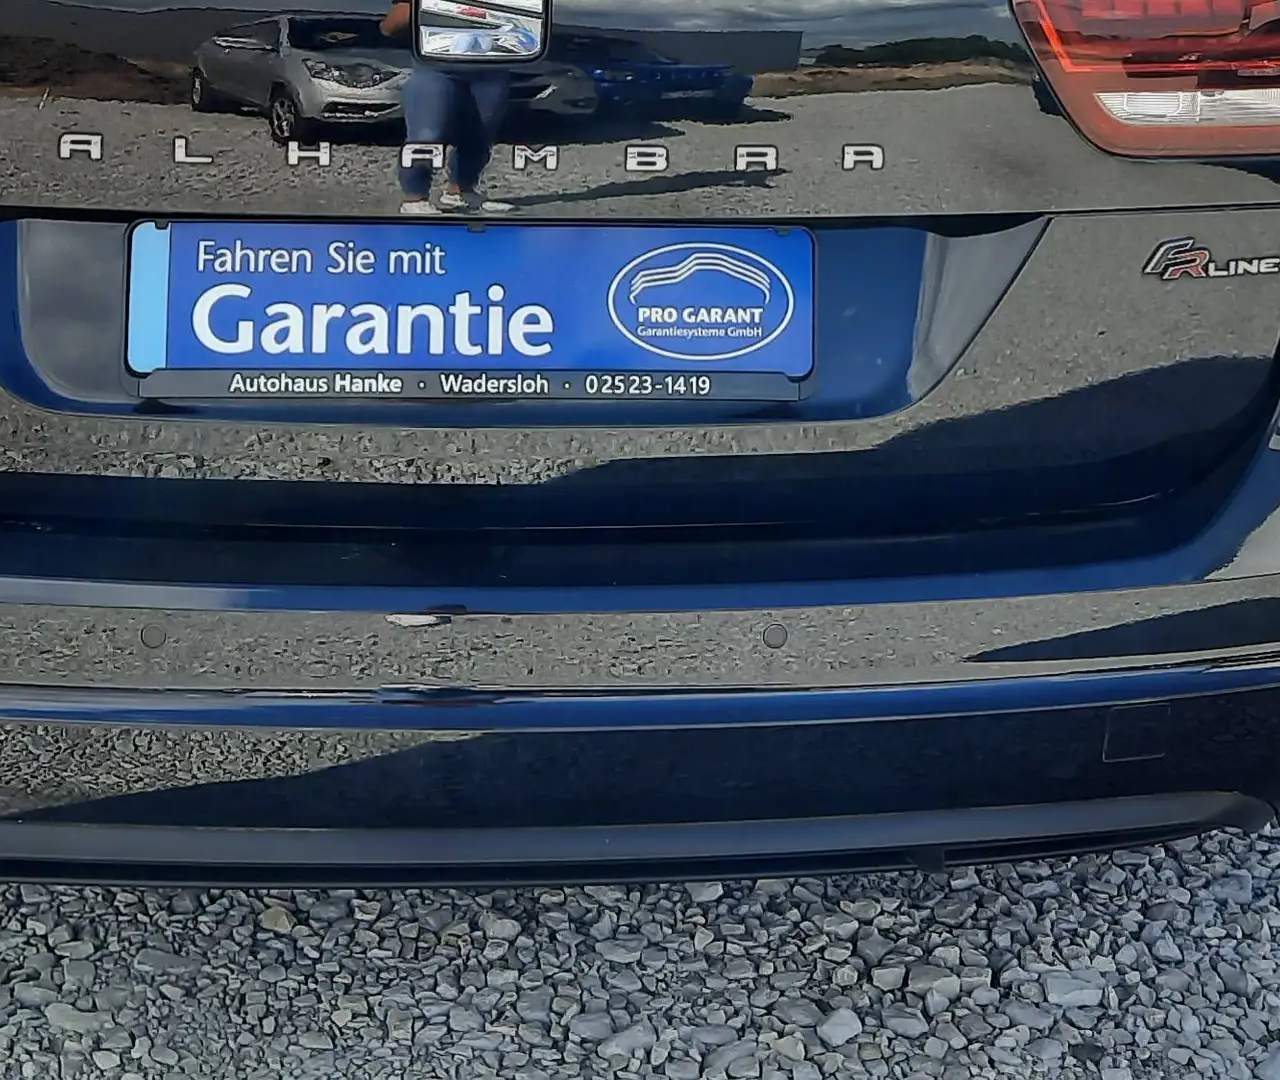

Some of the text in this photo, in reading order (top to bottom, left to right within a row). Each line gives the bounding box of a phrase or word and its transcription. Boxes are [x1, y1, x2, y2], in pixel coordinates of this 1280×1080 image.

[59, 132, 884, 171] ALHAMBRA
[197, 239, 447, 275] Fahren Sie mit
[191, 282, 554, 357] Garantie
[638, 307, 764, 324] PRO GARANT
[637, 326, 762, 340] Garantiesysteme GmbH
[229, 373, 710, 396] Autohaus Hanke Wadersloh 02523-1419
